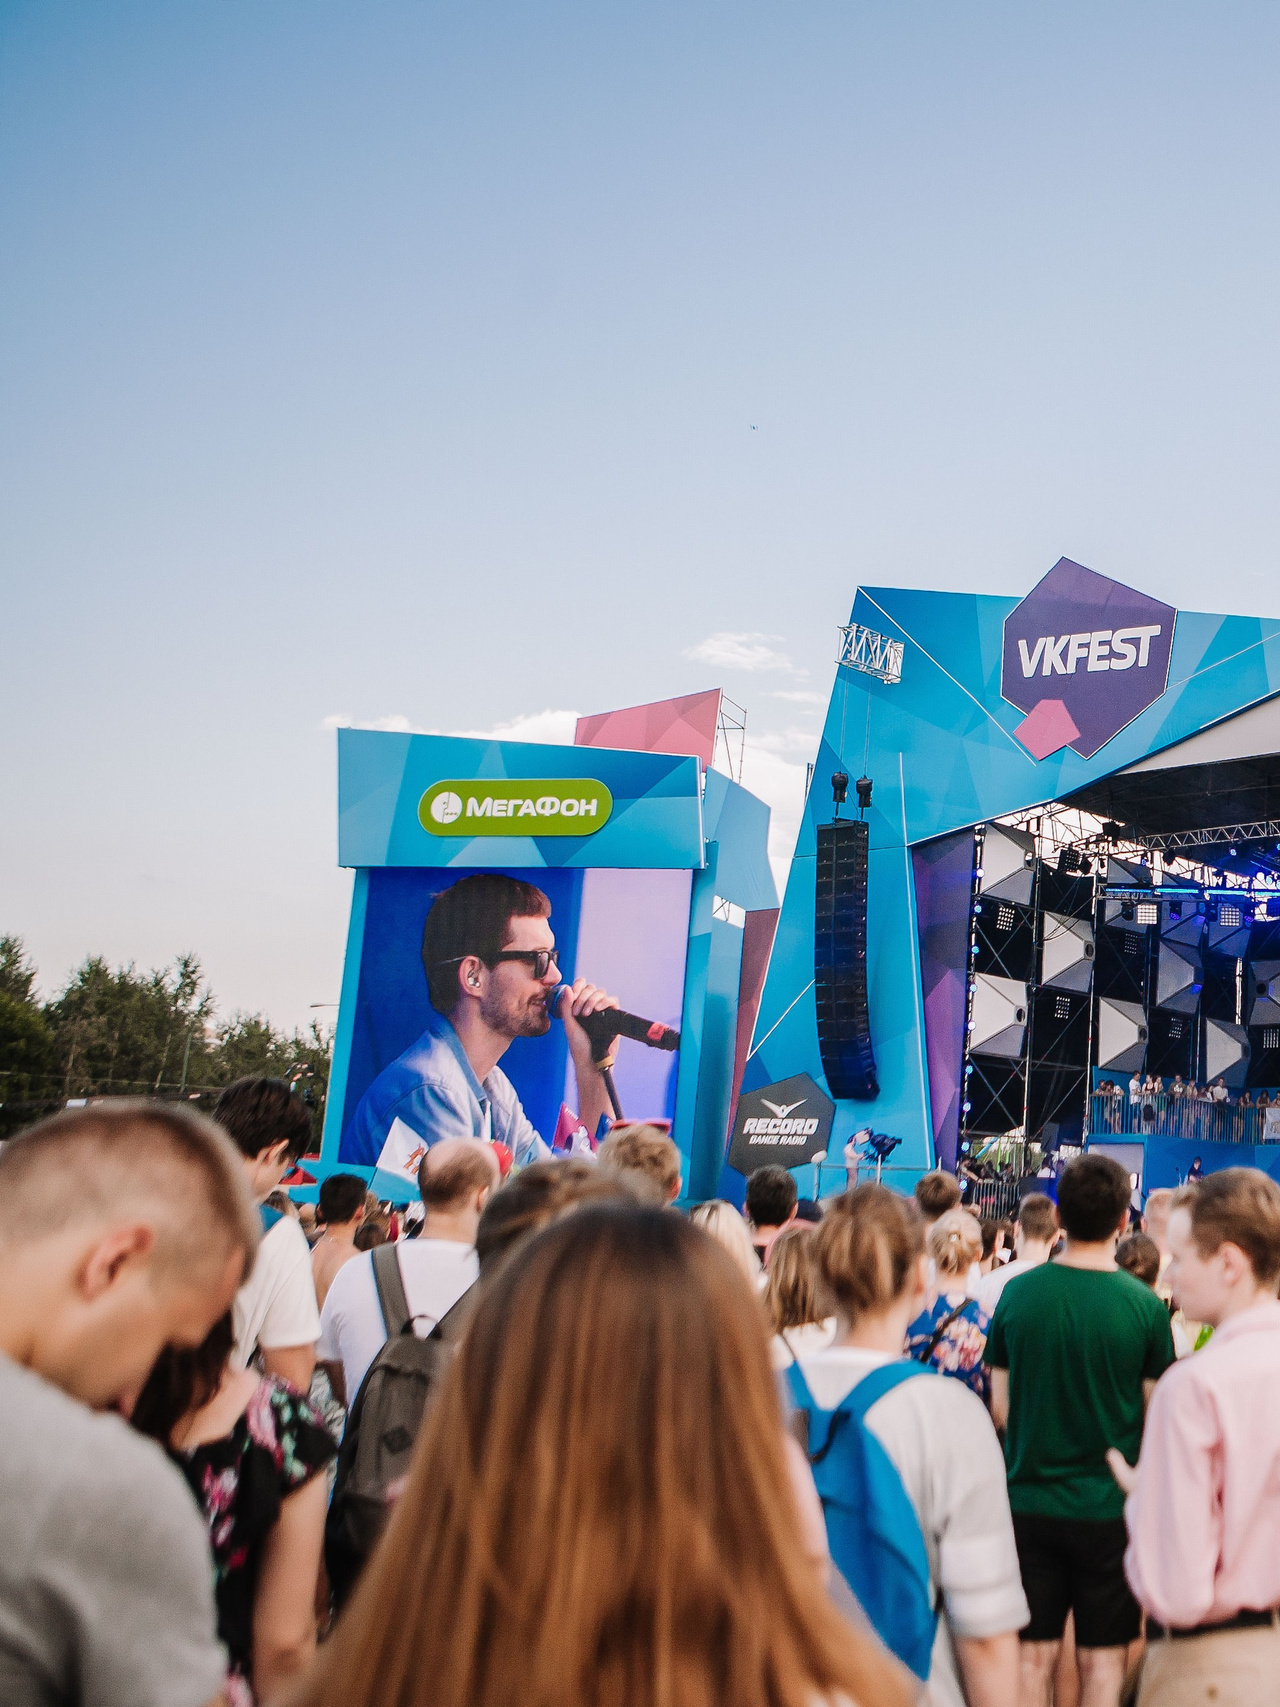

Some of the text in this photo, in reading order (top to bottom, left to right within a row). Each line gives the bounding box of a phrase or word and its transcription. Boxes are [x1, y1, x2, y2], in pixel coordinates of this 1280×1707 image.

[1018, 625, 1161, 678] VKFEST
[743, 1118, 819, 1135] RECORD
[749, 1135, 808, 1146] DANCE RADIO
